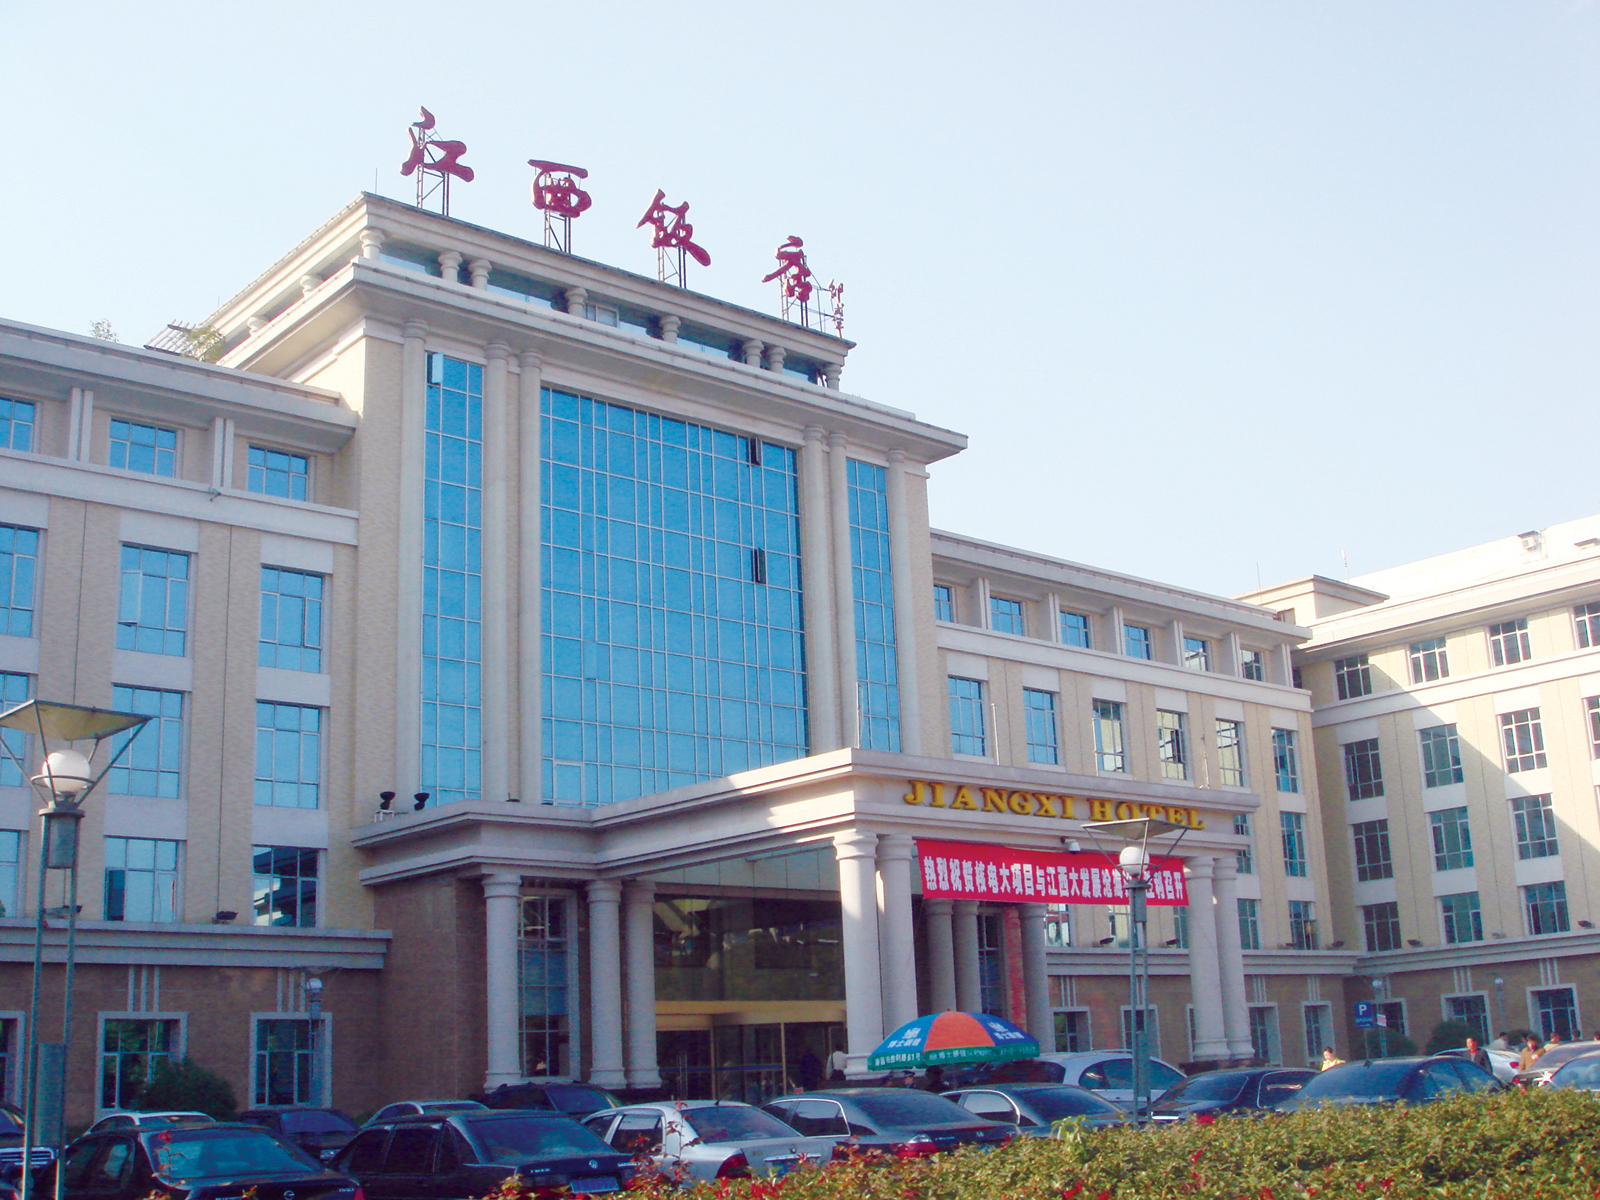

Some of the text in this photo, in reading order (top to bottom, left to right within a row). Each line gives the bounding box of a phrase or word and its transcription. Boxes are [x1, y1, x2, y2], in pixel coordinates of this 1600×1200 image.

[903, 780, 1206, 829] JIANGXI HOTEL
[1359, 1004, 1367, 1016] P
